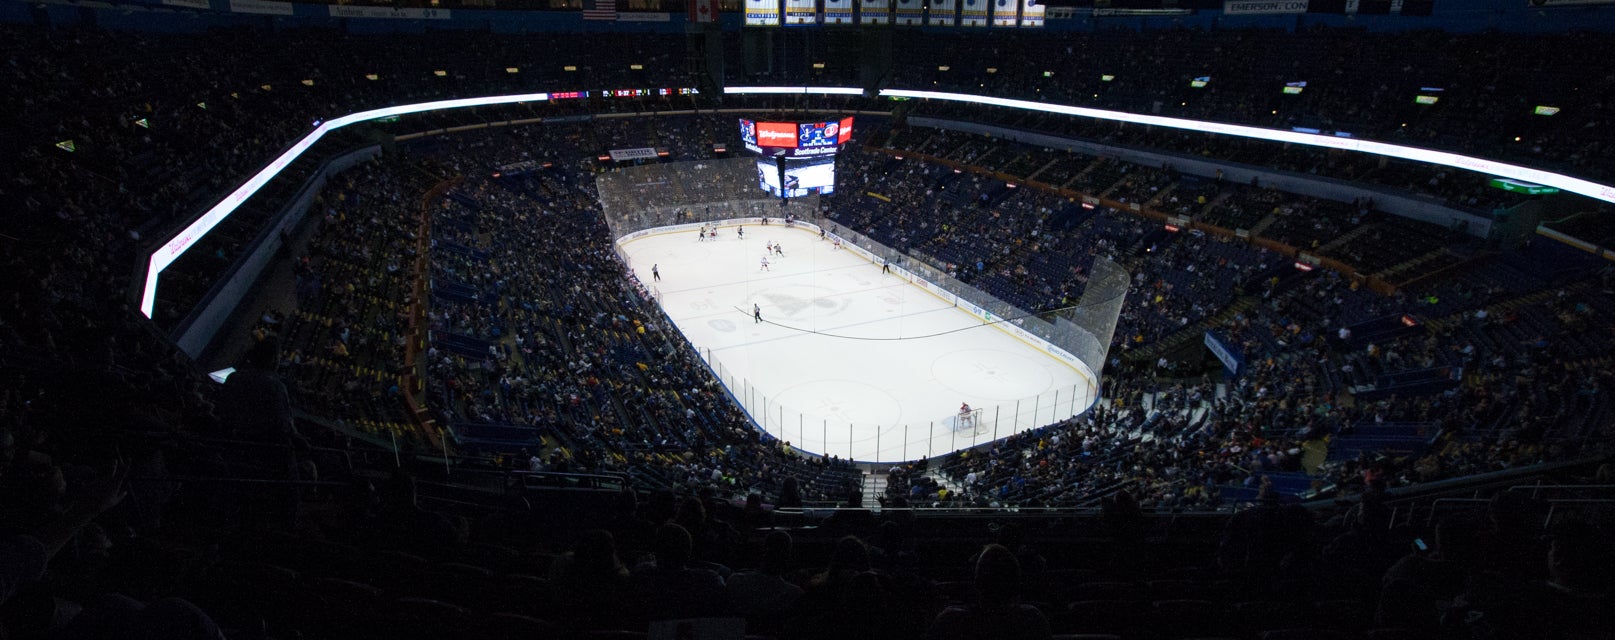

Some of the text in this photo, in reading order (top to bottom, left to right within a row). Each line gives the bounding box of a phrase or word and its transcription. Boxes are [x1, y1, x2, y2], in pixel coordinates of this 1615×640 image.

[758, 130, 795, 139] Walgreens
[794, 146, 838, 156] Scottrade Center
